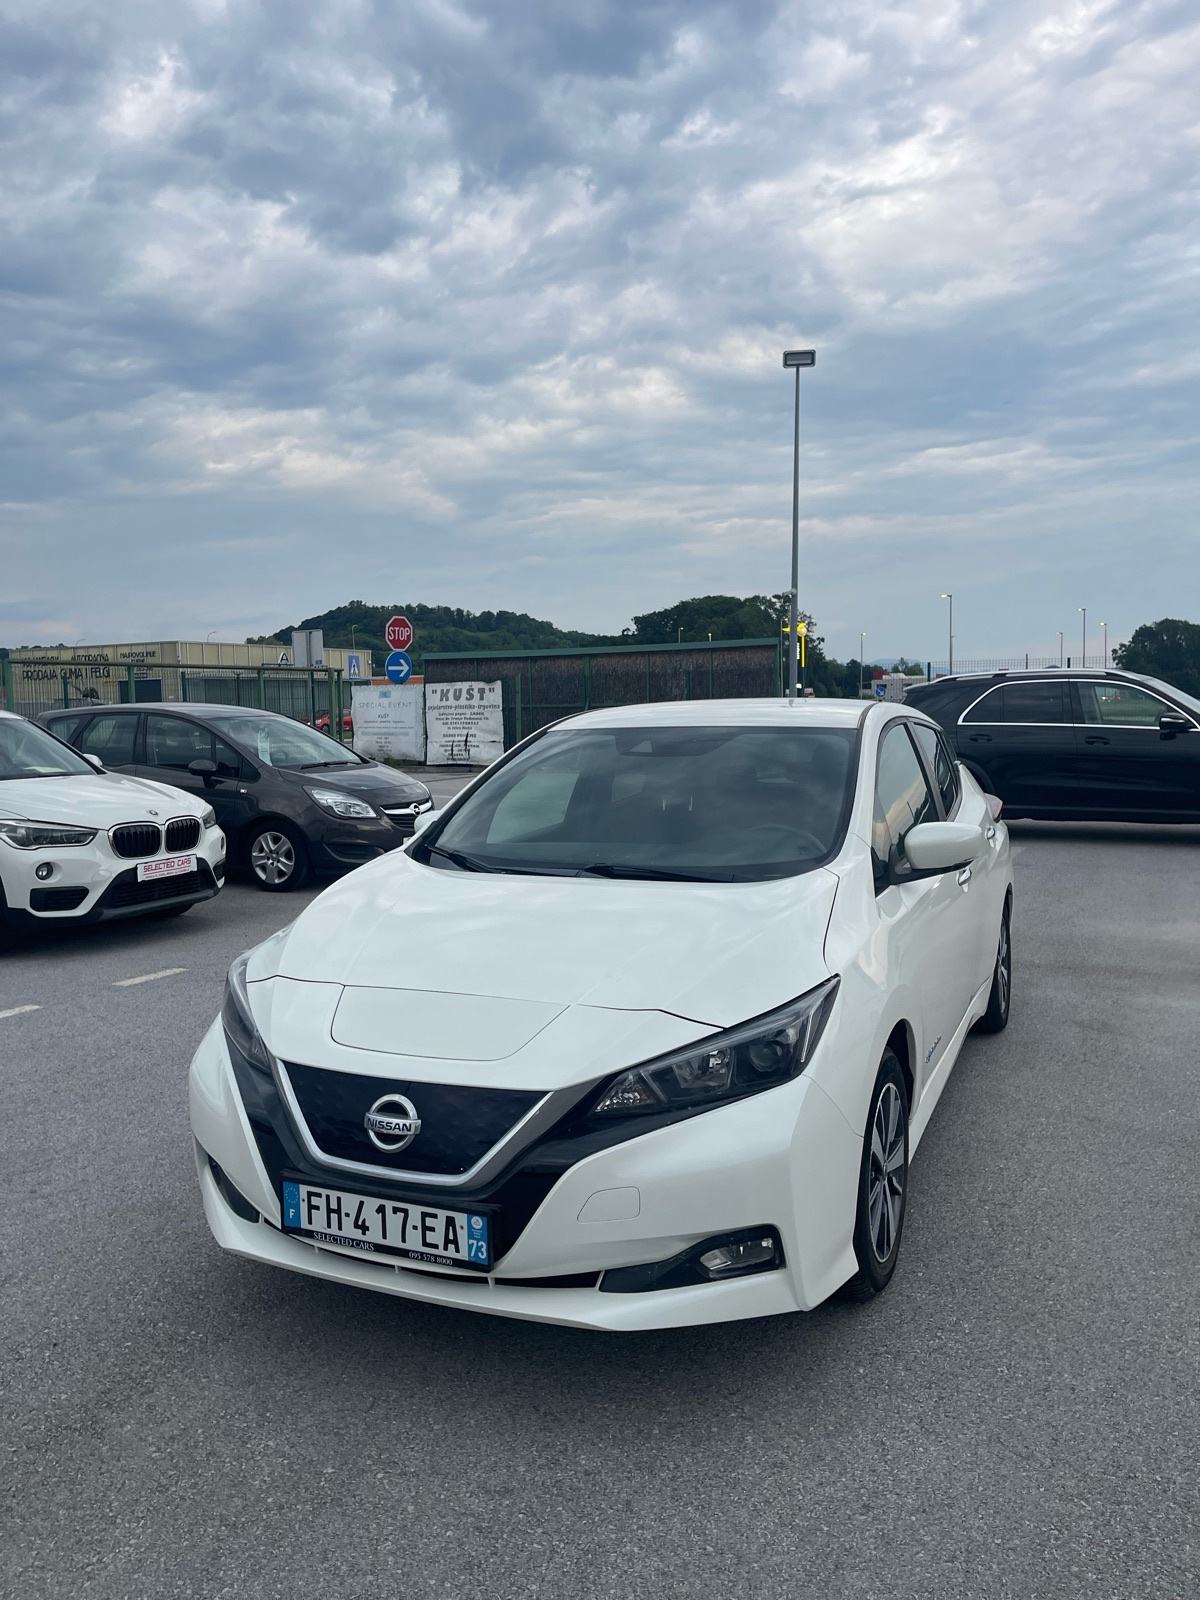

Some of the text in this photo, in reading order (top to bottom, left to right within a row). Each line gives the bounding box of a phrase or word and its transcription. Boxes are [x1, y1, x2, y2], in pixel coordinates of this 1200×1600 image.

[388, 626, 410, 640] STOP
[22, 670, 58, 681] PRODAJA
[388, 701, 413, 709] EVENT
[143, 857, 192, 873] SELECTED CARS
[367, 1117, 412, 1132] NISSAN
[289, 1209, 295, 1219] F
[313, 1231, 375, 1251] SELECTED CARS
[468, 1239, 487, 1259] 73
[408, 1251, 453, 1265] 095 578 8000
